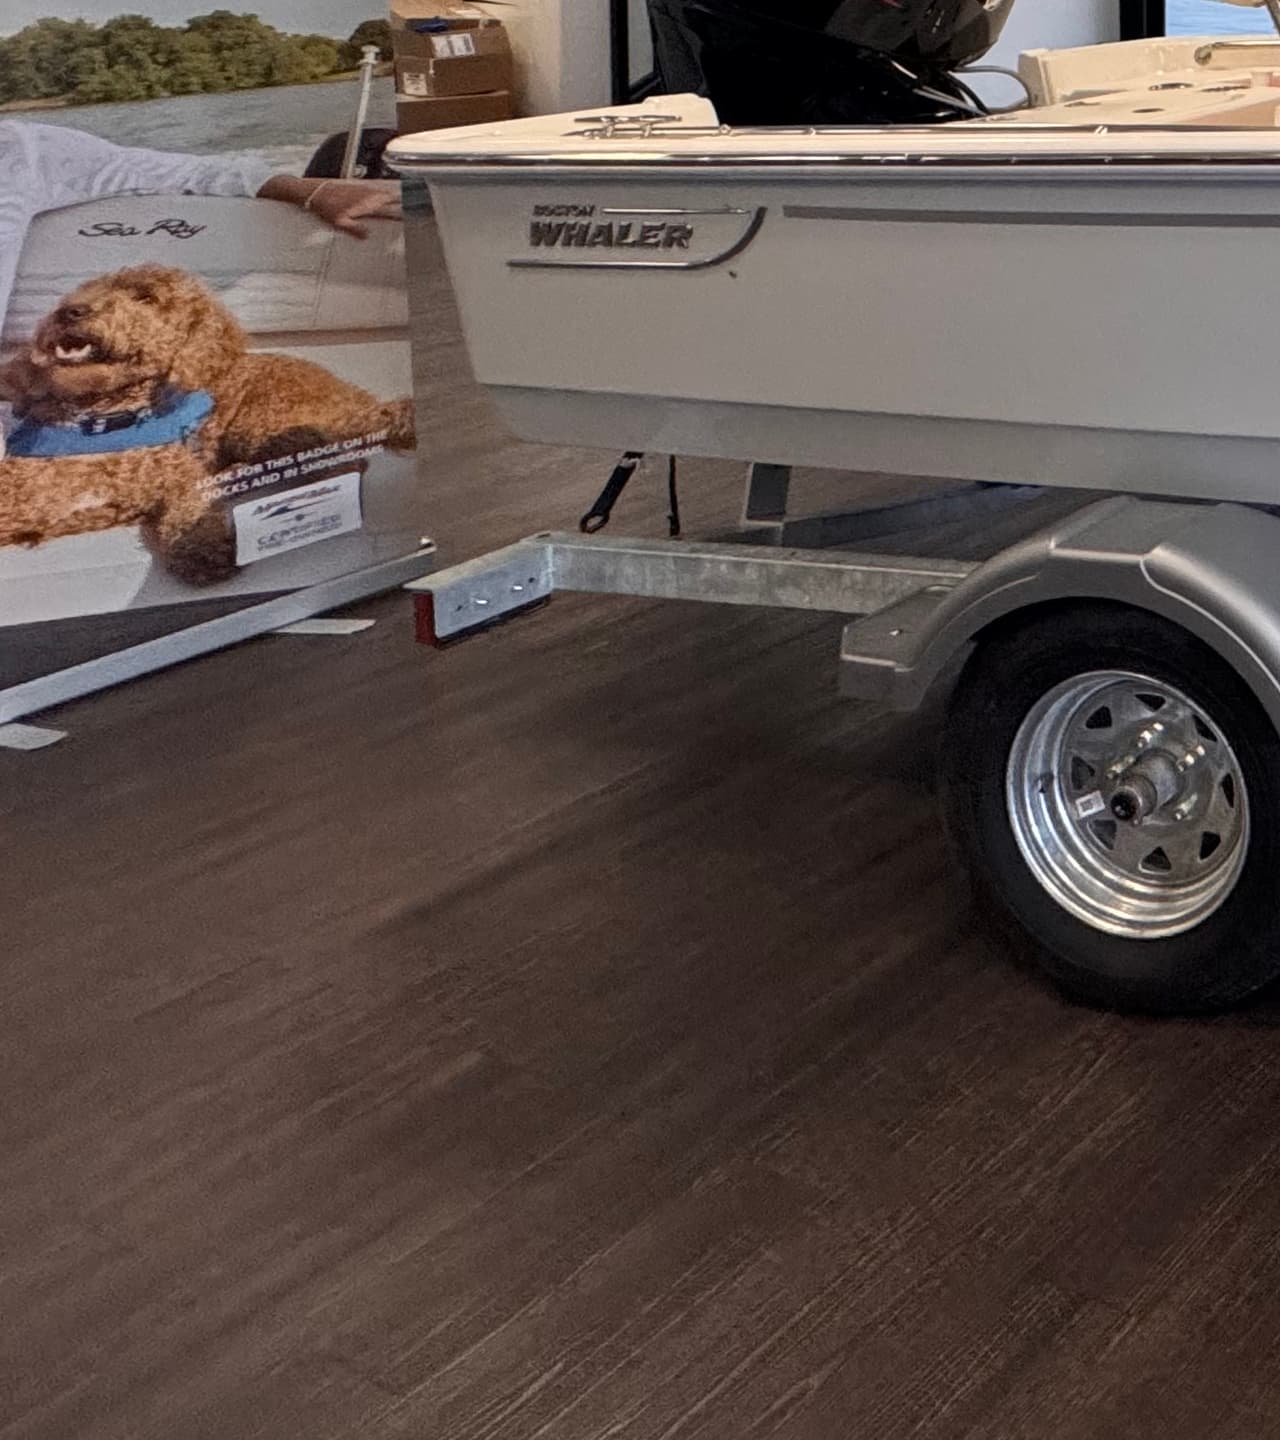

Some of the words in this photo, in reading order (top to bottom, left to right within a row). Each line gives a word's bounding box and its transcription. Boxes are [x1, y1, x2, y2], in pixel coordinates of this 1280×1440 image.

[532, 204, 596, 217] BOSTON
[78, 222, 142, 237] Sea
[145, 218, 208, 239] Ray
[530, 221, 694, 249] WHALER
[195, 471, 233, 490] LOOK
[235, 463, 263, 479] FOR
[264, 454, 294, 470] THIS
[297, 442, 340, 462] BADGE
[343, 436, 362, 449] ON
[366, 429, 388, 444] THE
[201, 480, 249, 502] DOCKS
[251, 472, 281, 488] AND
[283, 466, 298, 478] IN
[300, 444, 384, 474] SHOWROOMS
